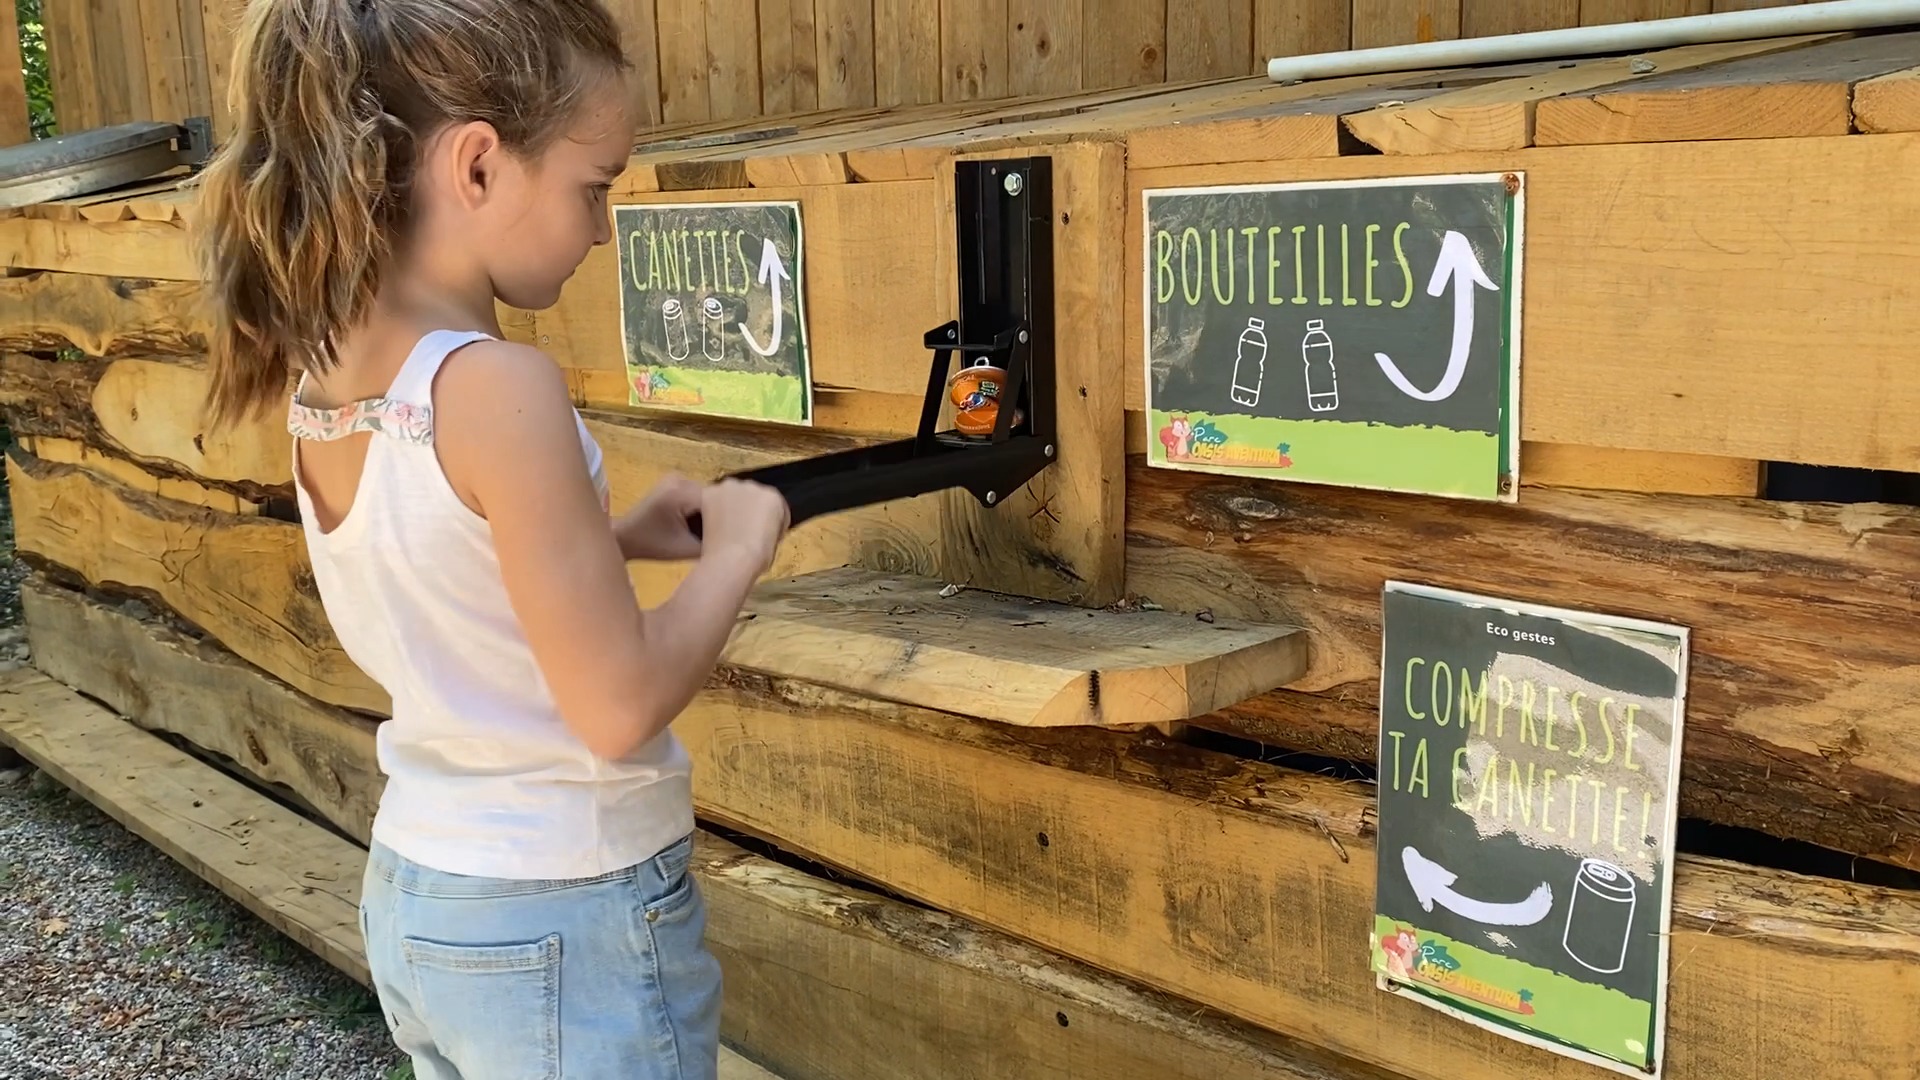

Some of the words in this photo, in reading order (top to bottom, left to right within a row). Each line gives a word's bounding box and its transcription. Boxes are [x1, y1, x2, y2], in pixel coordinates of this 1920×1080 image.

[629, 228, 751, 295] CANETTES
[1156, 221, 1415, 308] BOUTEILLES
[1193, 427, 1222, 443] Parc
[1486, 622, 1509, 637] Eco
[1512, 629, 1556, 646] gestes
[1405, 656, 1641, 771] COMPRESSE
[1388, 731, 1429, 798] TA
[1450, 747, 1652, 859] CANETTE!
[1421, 945, 1453, 969] Parc
